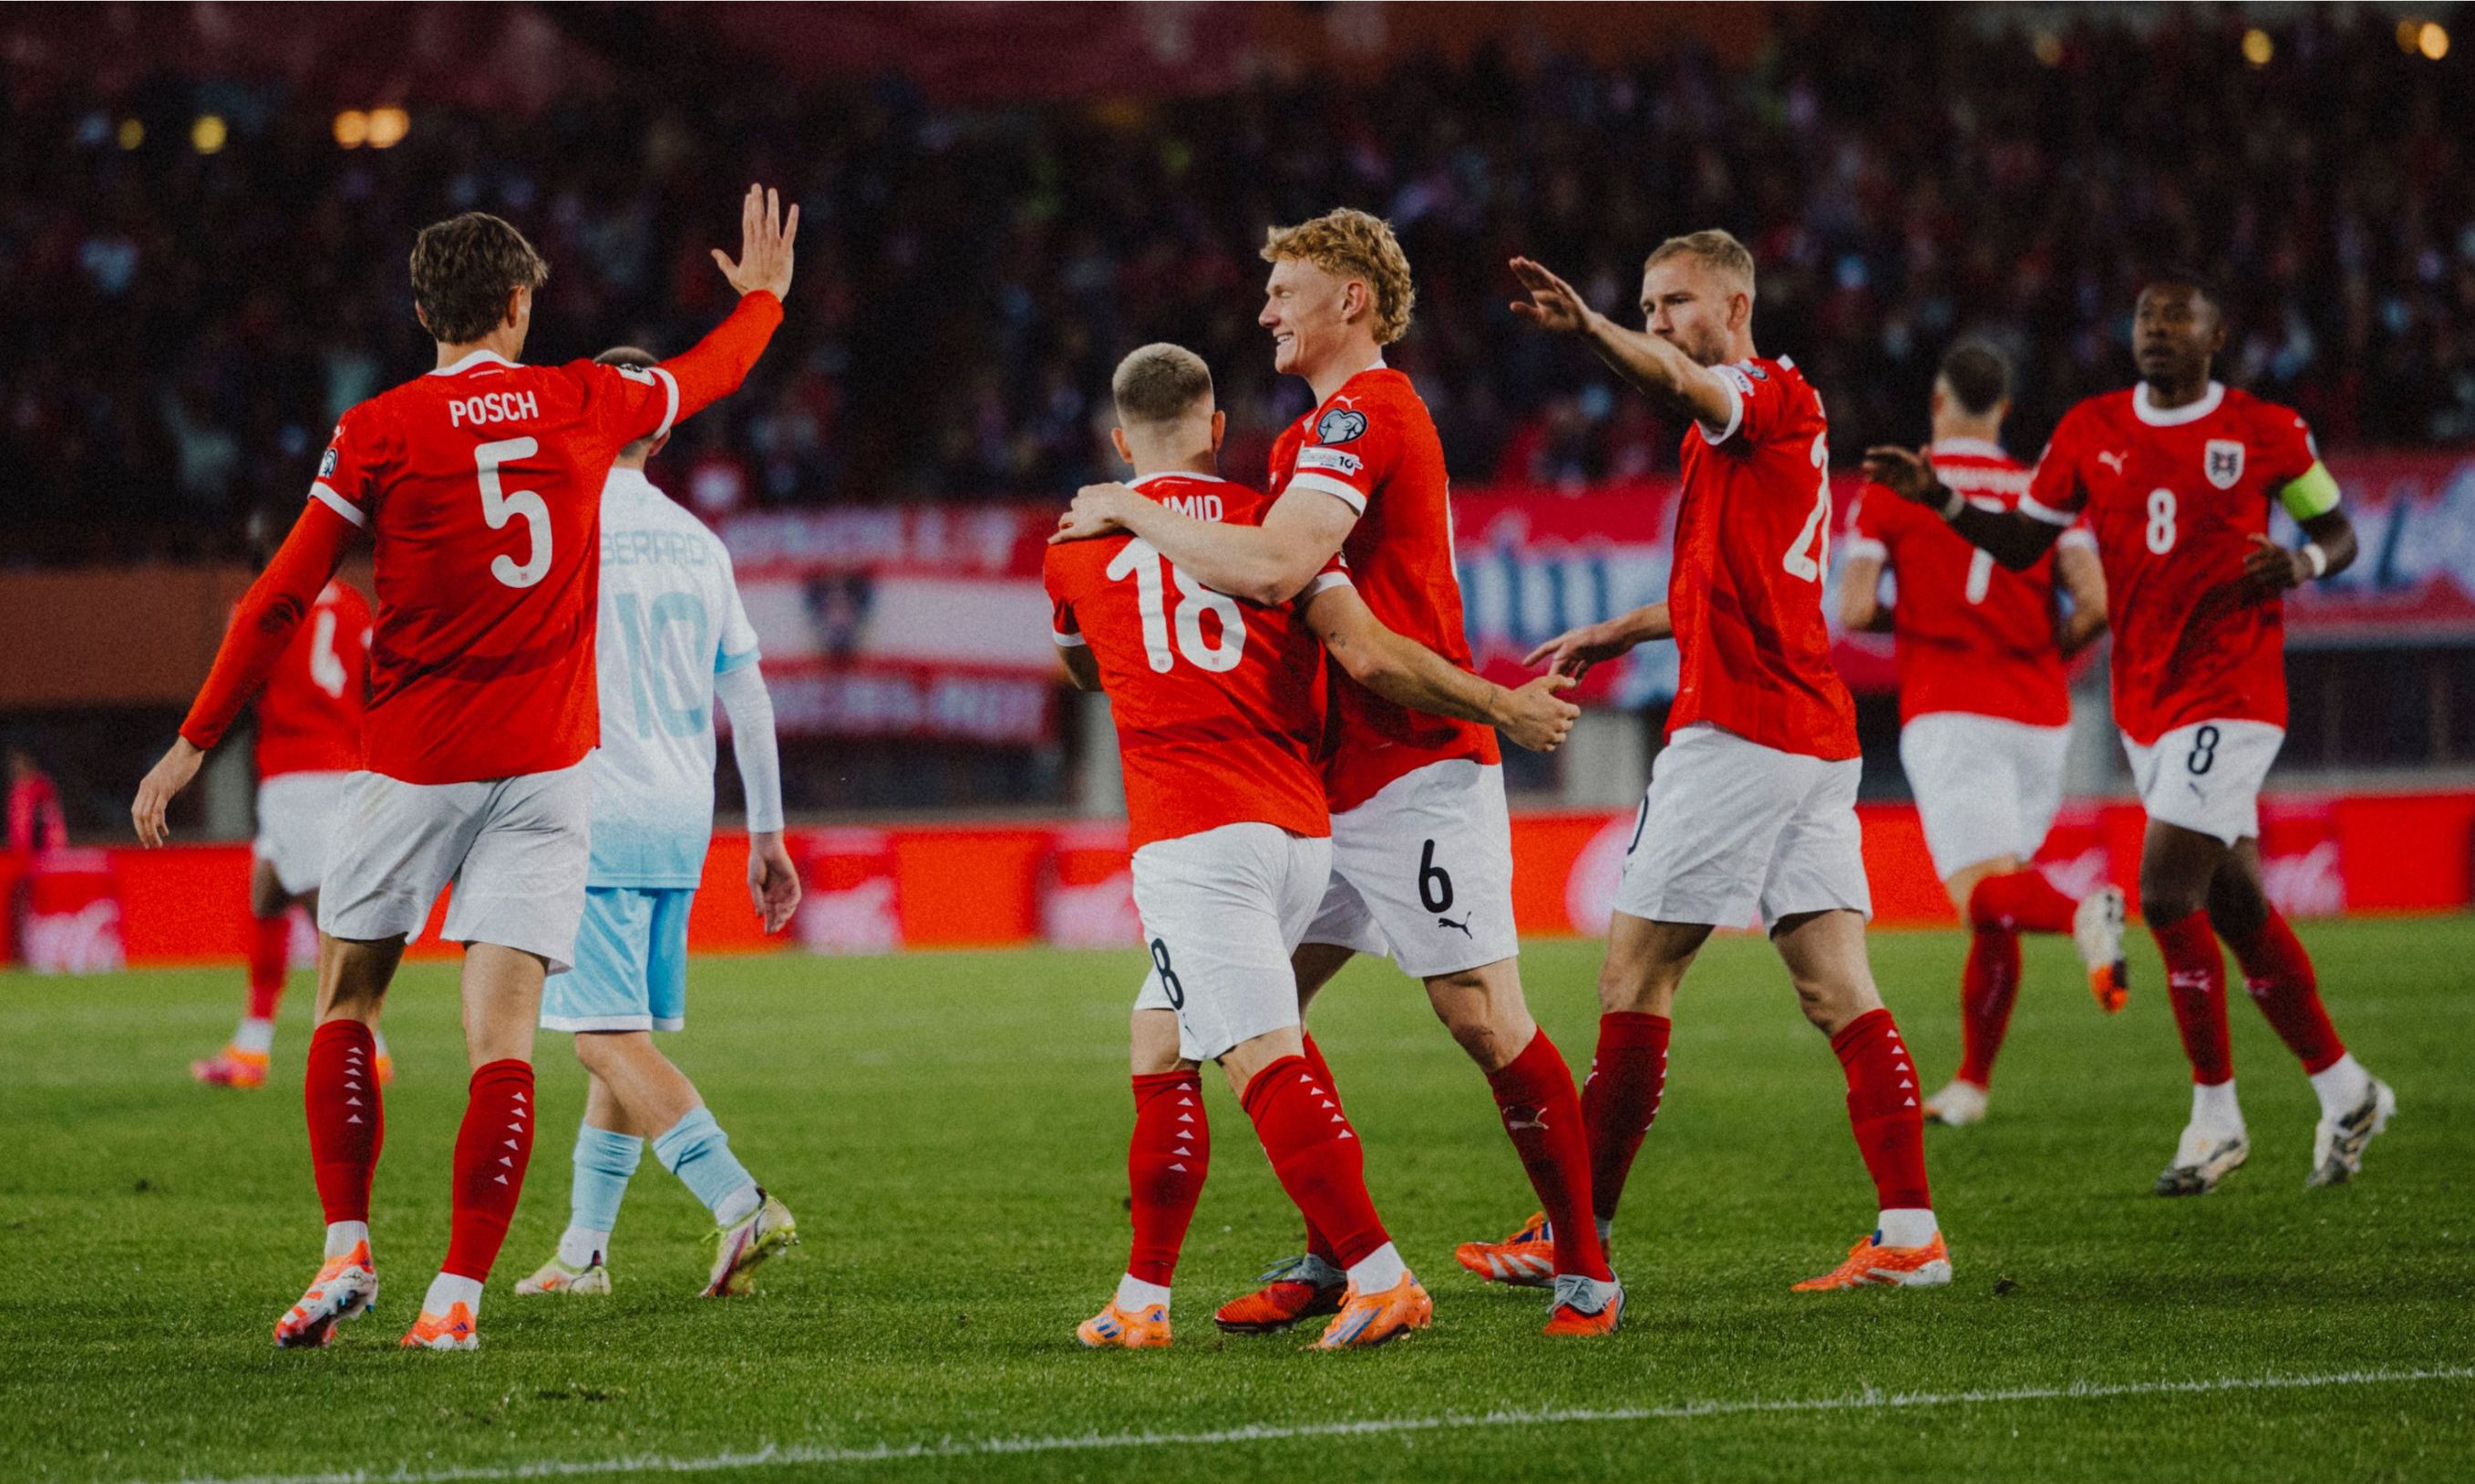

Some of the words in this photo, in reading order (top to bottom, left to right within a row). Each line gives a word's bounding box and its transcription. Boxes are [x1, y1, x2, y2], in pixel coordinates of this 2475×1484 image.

[449, 390, 539, 428] POSCH
[474, 436, 553, 589] 5
[1163, 495, 1223, 522] MID
[1783, 431, 1832, 585] 2
[2145, 487, 2177, 555] 8
[1106, 536, 1247, 674] 18
[614, 592, 708, 738] 10
[2188, 726, 2220, 776] 8
[1418, 839, 1454, 913] 6
[1150, 938, 1184, 1011] 8
